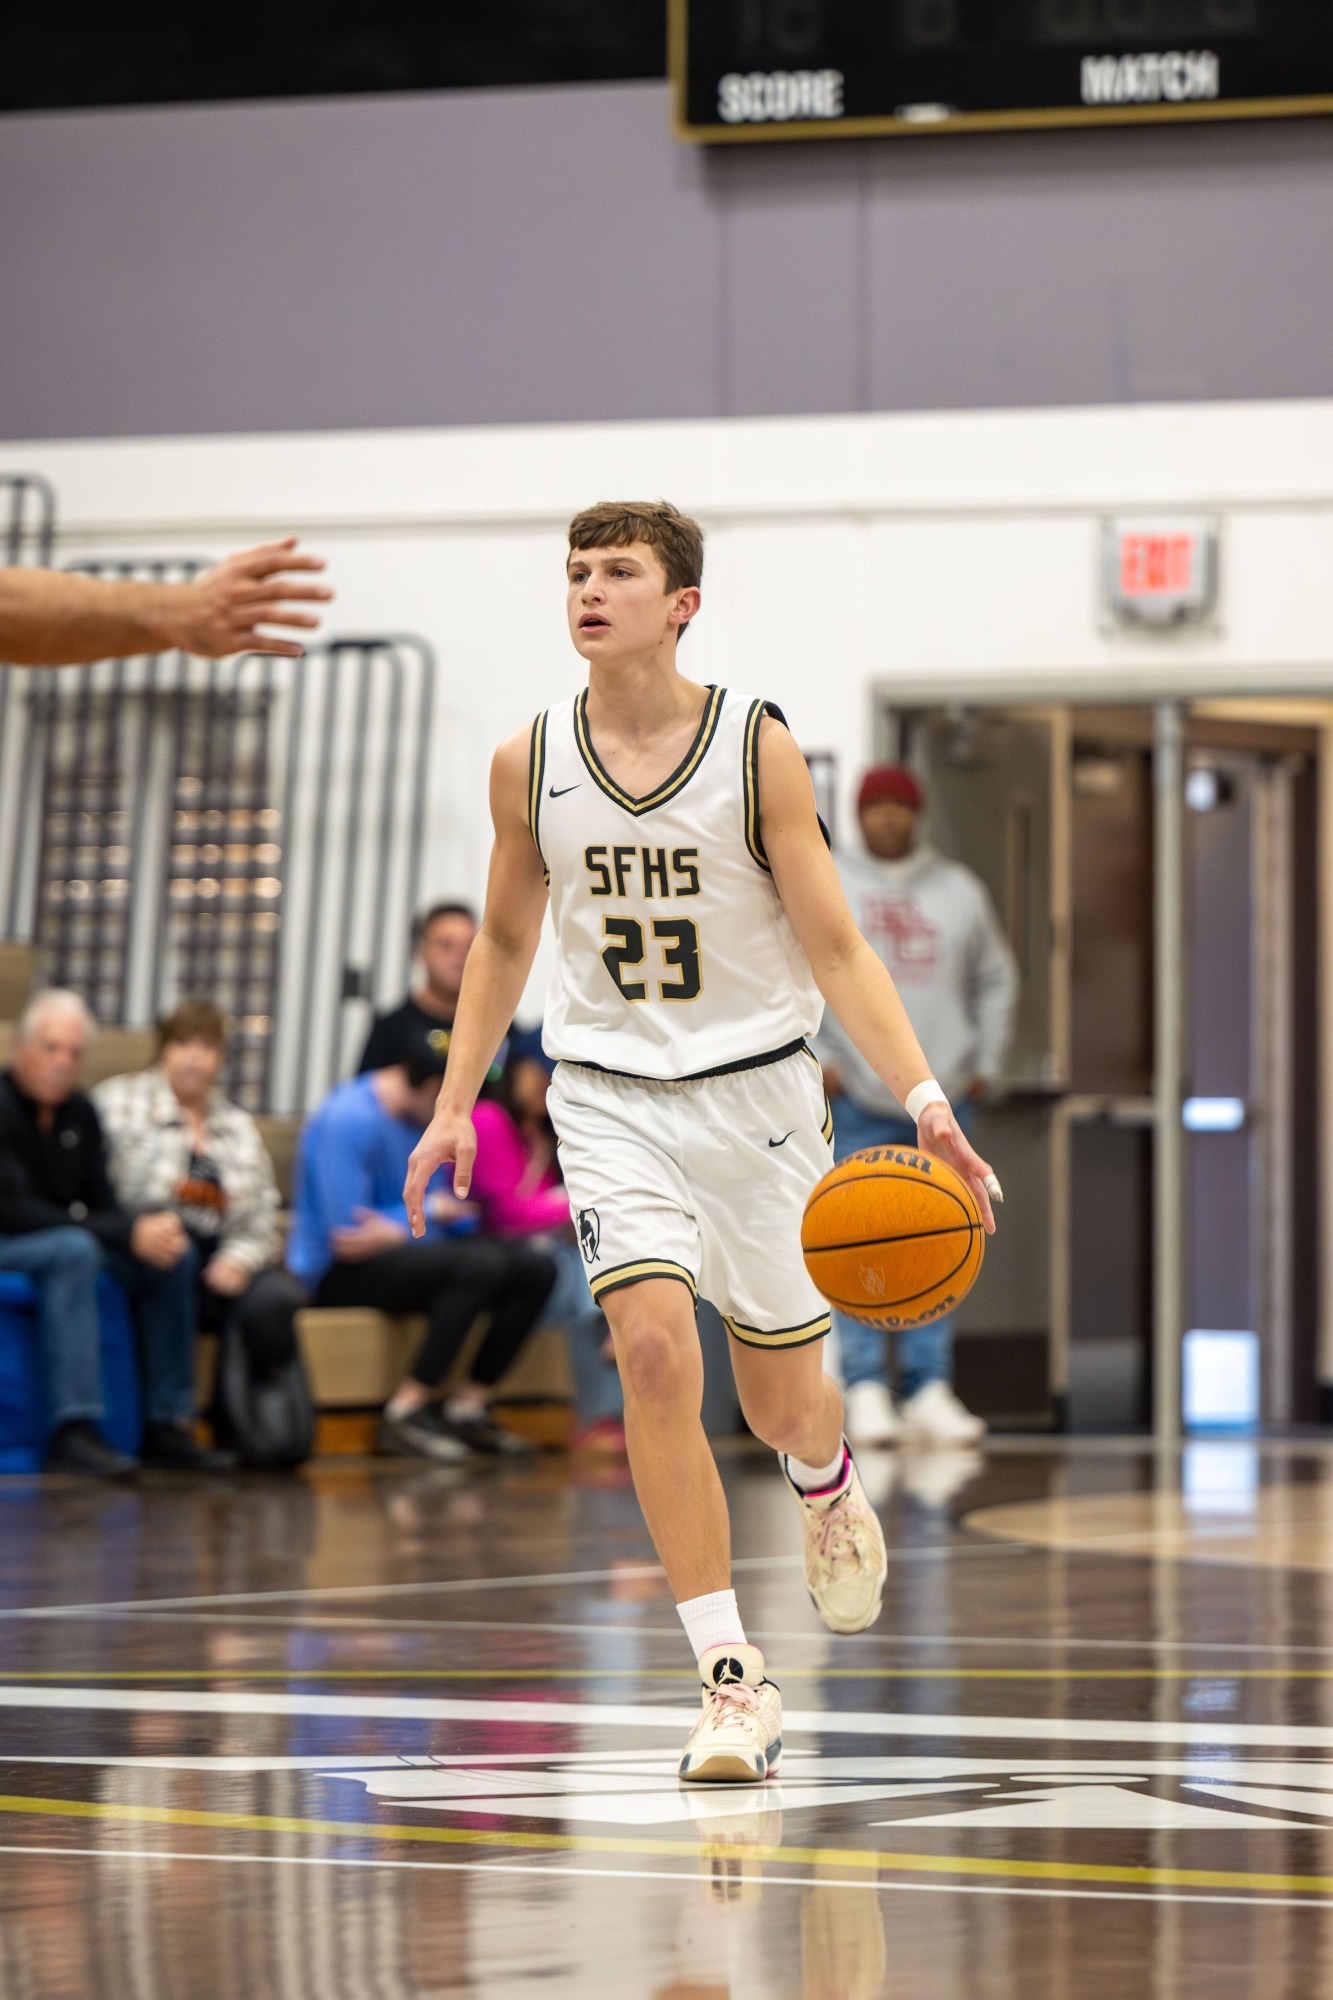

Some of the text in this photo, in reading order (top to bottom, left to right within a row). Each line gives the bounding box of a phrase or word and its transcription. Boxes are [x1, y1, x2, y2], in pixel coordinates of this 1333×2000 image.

[718, 69, 844, 122] SCORE
[1081, 50, 1219, 105] MATCH
[1120, 533, 1194, 593] EXIT
[584, 843, 702, 899] SFHS
[600, 914, 704, 1003] 23
